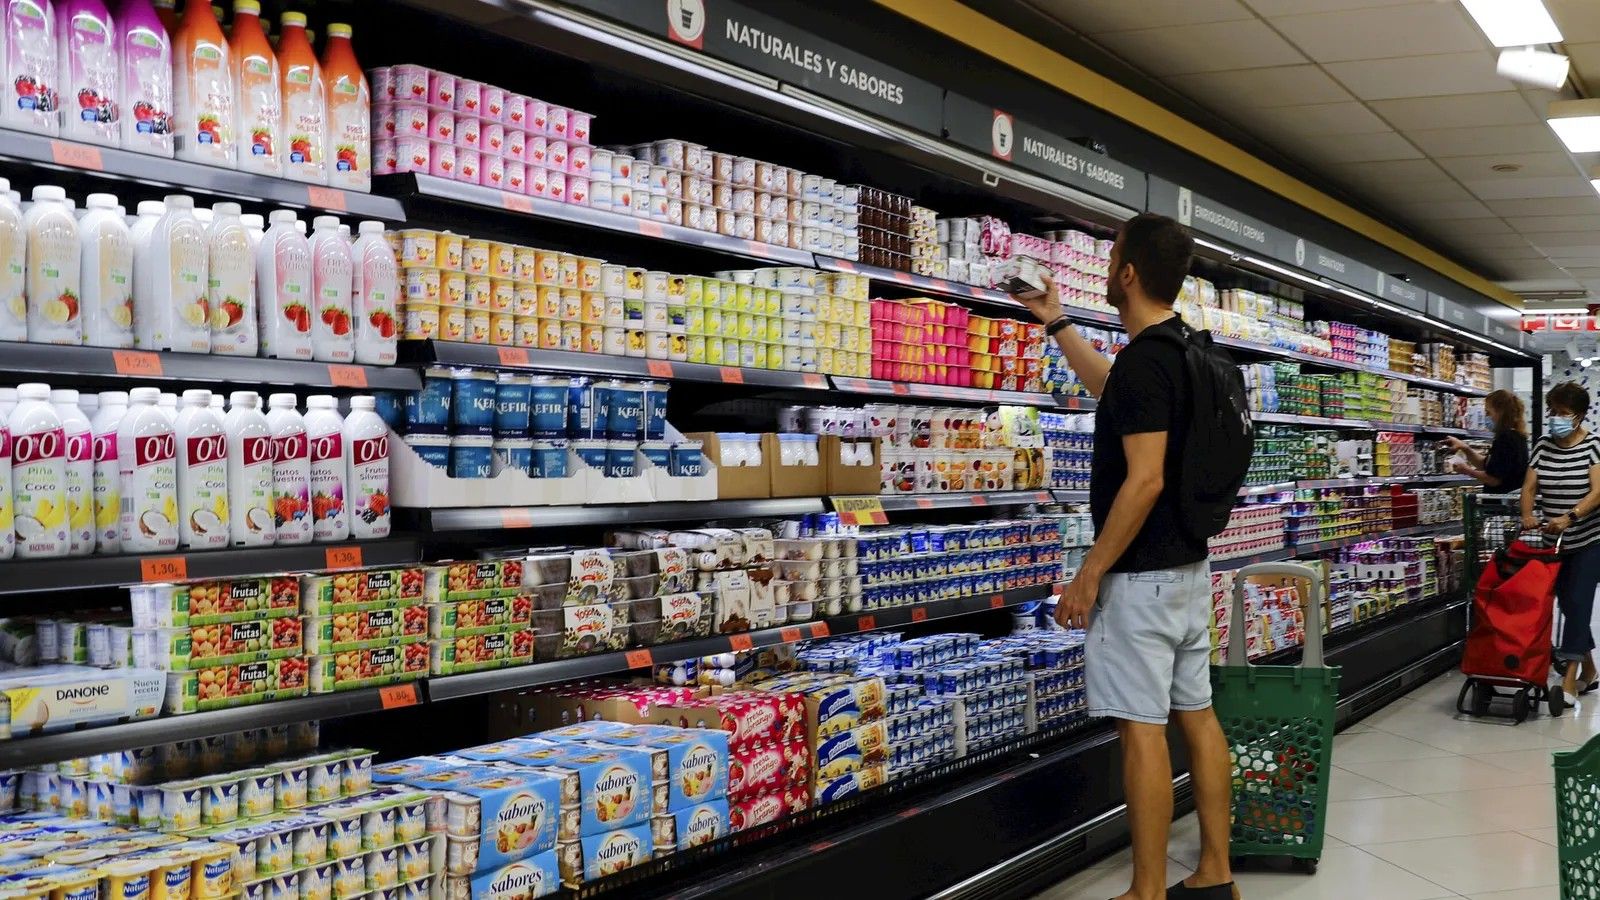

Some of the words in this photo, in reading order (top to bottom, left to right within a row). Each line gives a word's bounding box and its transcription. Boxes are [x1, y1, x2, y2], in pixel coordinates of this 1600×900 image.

[726, 19, 822, 73] NATURALES
[826, 58, 836, 79] Y
[839, 65, 903, 105] SABORES
[1023, 136, 1078, 171] NATURALES
[1079, 159, 1085, 174] Y
[1086, 162, 1125, 190] SABORES
[25, 483, 56, 491] Coco
[477, 568, 495, 578] frutas
[369, 578, 391, 588] frutas
[232, 587, 258, 598] frutas
[485, 604, 504, 614] frutas
[370, 616, 392, 626] frutas
[234, 628, 259, 639] frutas
[485, 640, 504, 649] frutas
[371, 653, 394, 664] frutas
[240, 668, 267, 680] frutas
[133, 679, 160, 687] Nueva
[134, 686, 159, 694] receta
[746, 709, 764, 725] fresa
[681, 751, 717, 771] sabores
[752, 753, 770, 770] fresa
[594, 772, 638, 793] sabores
[497, 800, 545, 823] sabores
[752, 800, 771, 817] fresa
[687, 814, 720, 835] sabores
[596, 837, 640, 862] sabores
[123, 879, 149, 894] Natura
[490, 869, 543, 895] sabores
